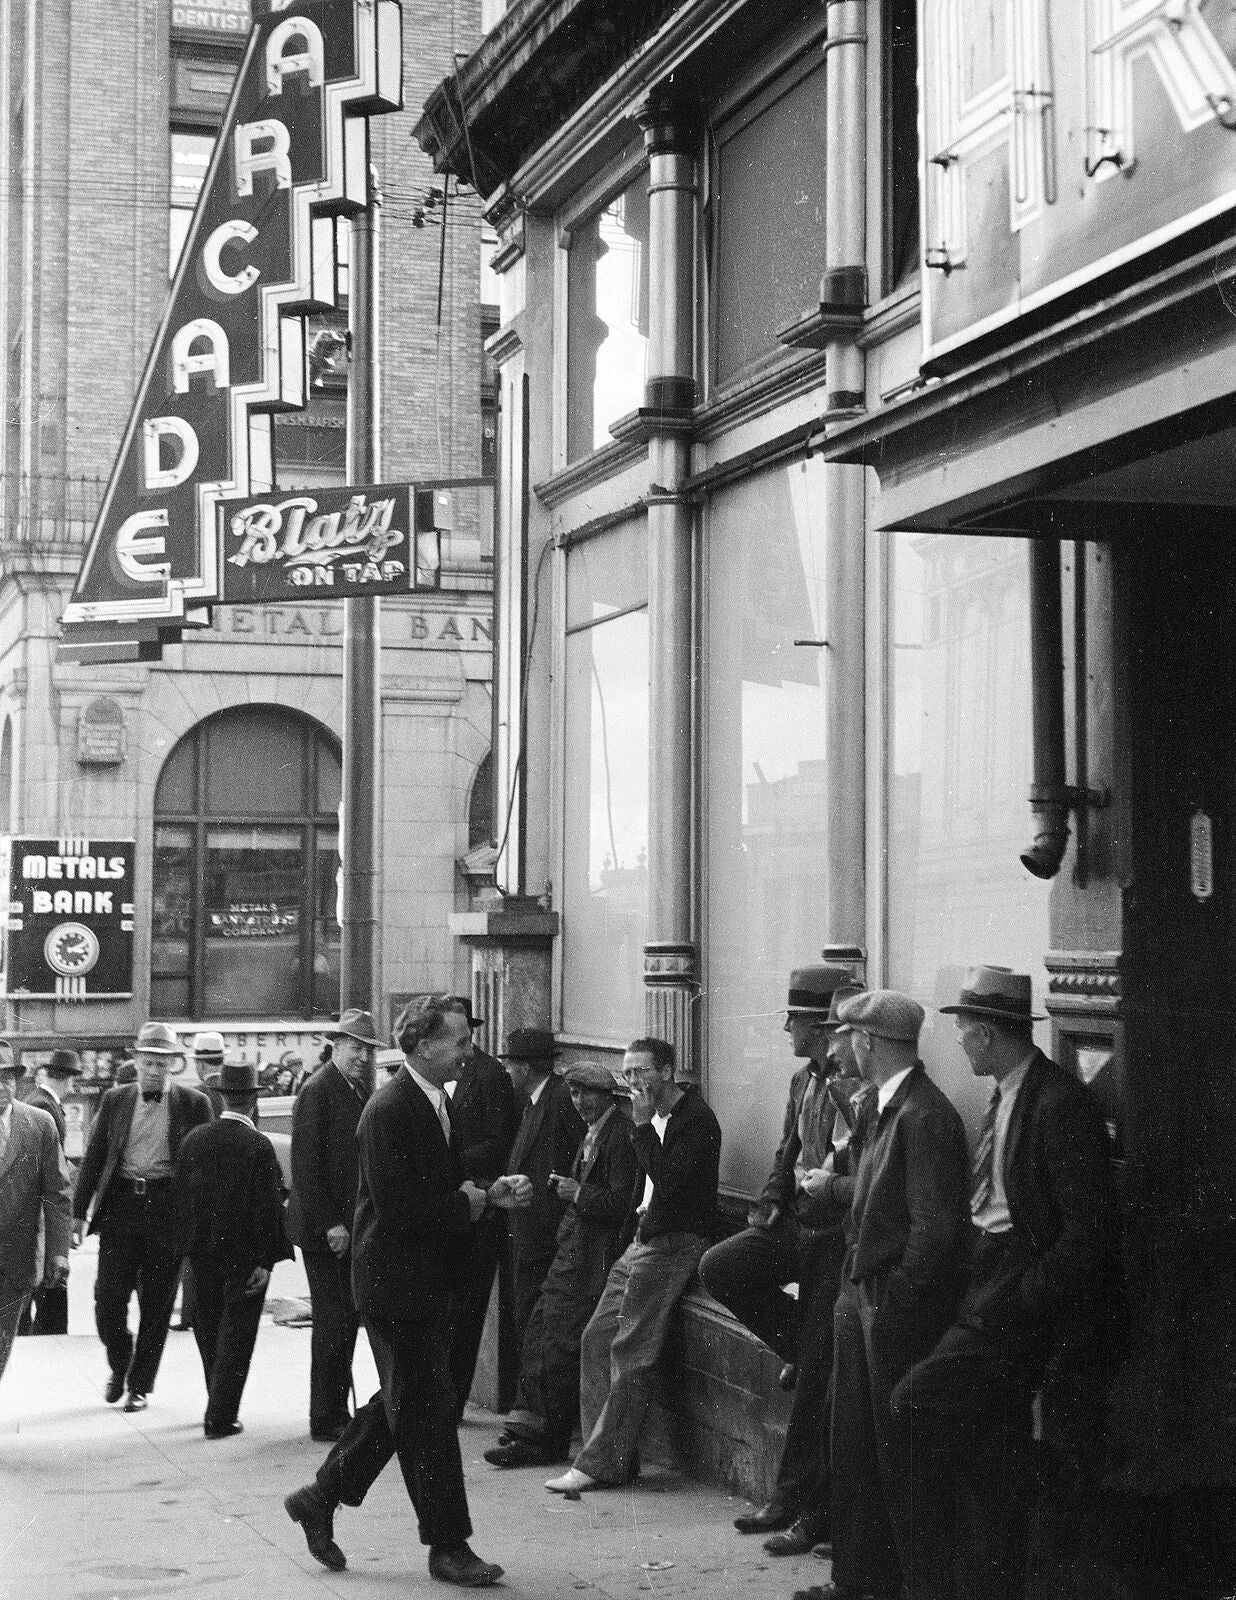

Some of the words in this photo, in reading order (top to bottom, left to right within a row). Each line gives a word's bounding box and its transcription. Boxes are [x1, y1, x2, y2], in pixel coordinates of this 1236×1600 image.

[172, 9, 250, 31] DENTIST
[115, 16, 325, 582] ARCADE
[288, 565, 335, 586] ON
[342, 561, 405, 584] TAP
[212, 607, 343, 637] ETAL
[410, 615, 493, 642] BAN
[22, 855, 126, 879] METALS
[33, 890, 113, 914] BANK
[182, 1032, 322, 1048] CBERTS
